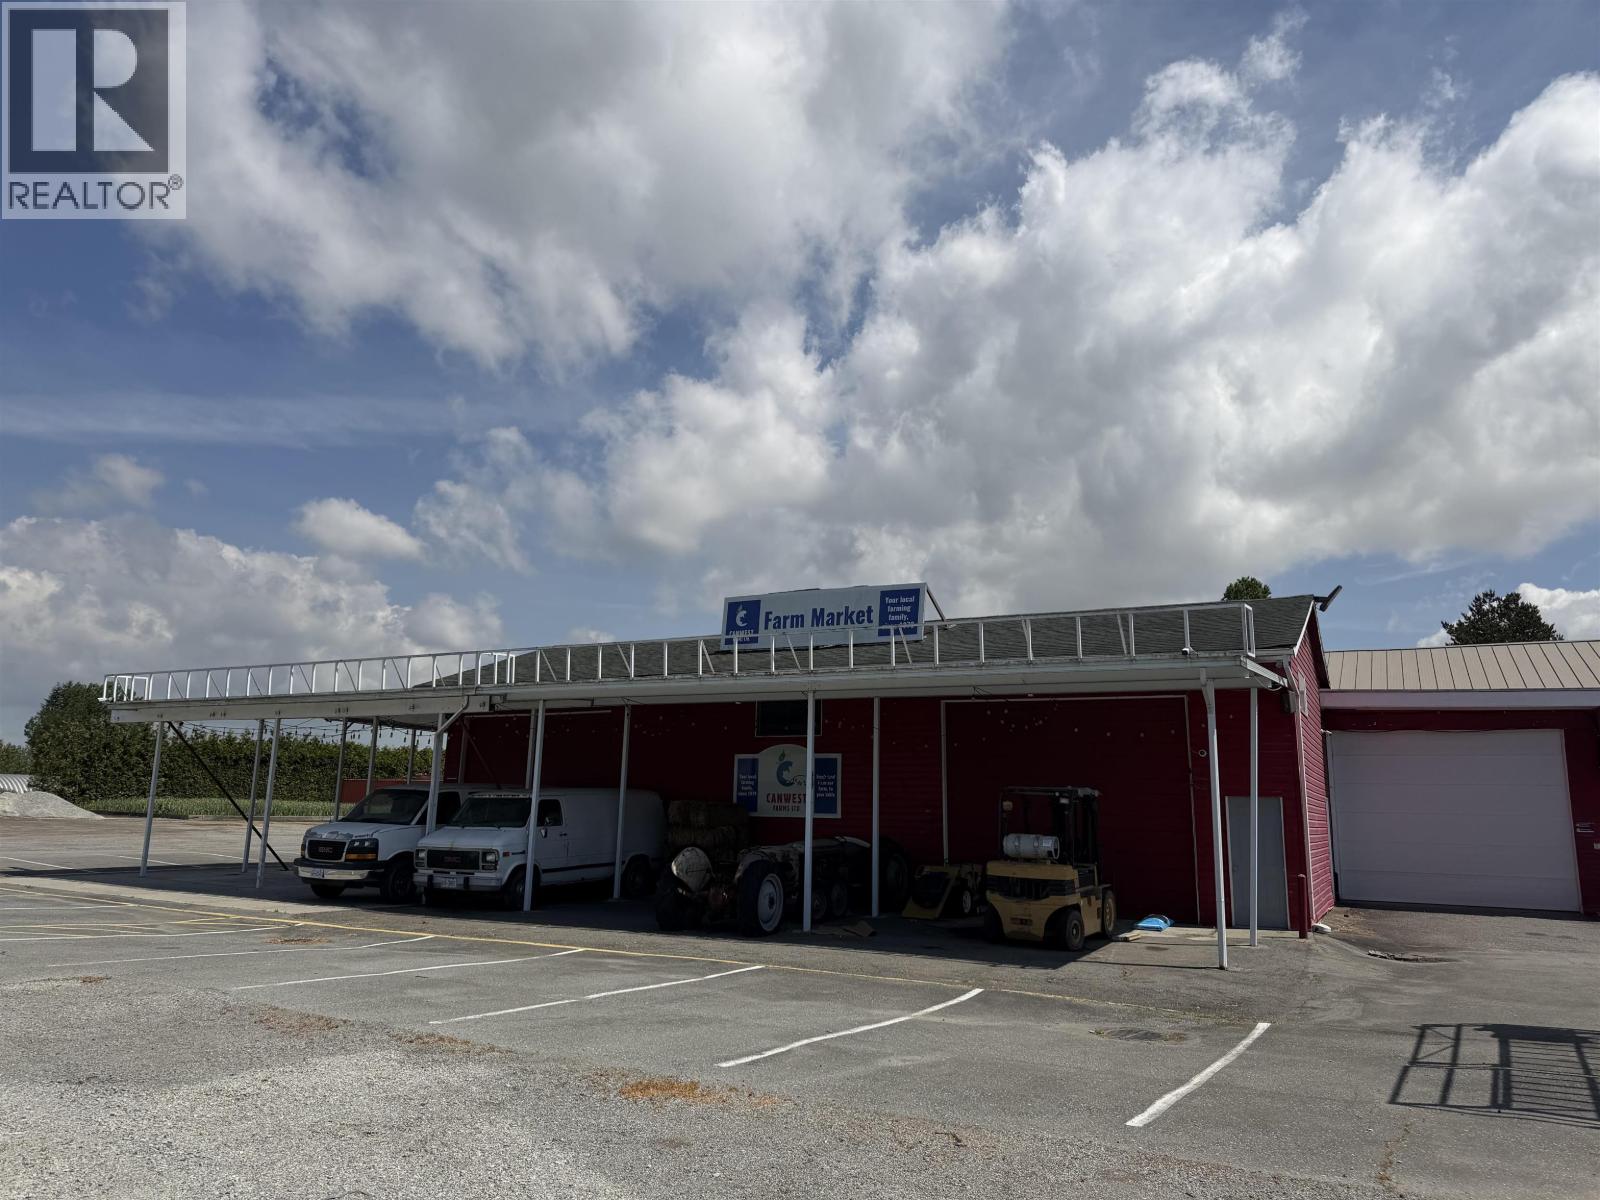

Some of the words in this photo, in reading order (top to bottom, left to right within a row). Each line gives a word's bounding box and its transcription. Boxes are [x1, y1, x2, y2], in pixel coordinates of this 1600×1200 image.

[885, 596, 898, 604] Your
[900, 595, 915, 603] local
[887, 604, 911, 613] farming
[764, 611, 804, 630] Farm
[811, 605, 873, 627] Market
[766, 793, 807, 803] CANWEST
[318, 846, 334, 854] GMC
